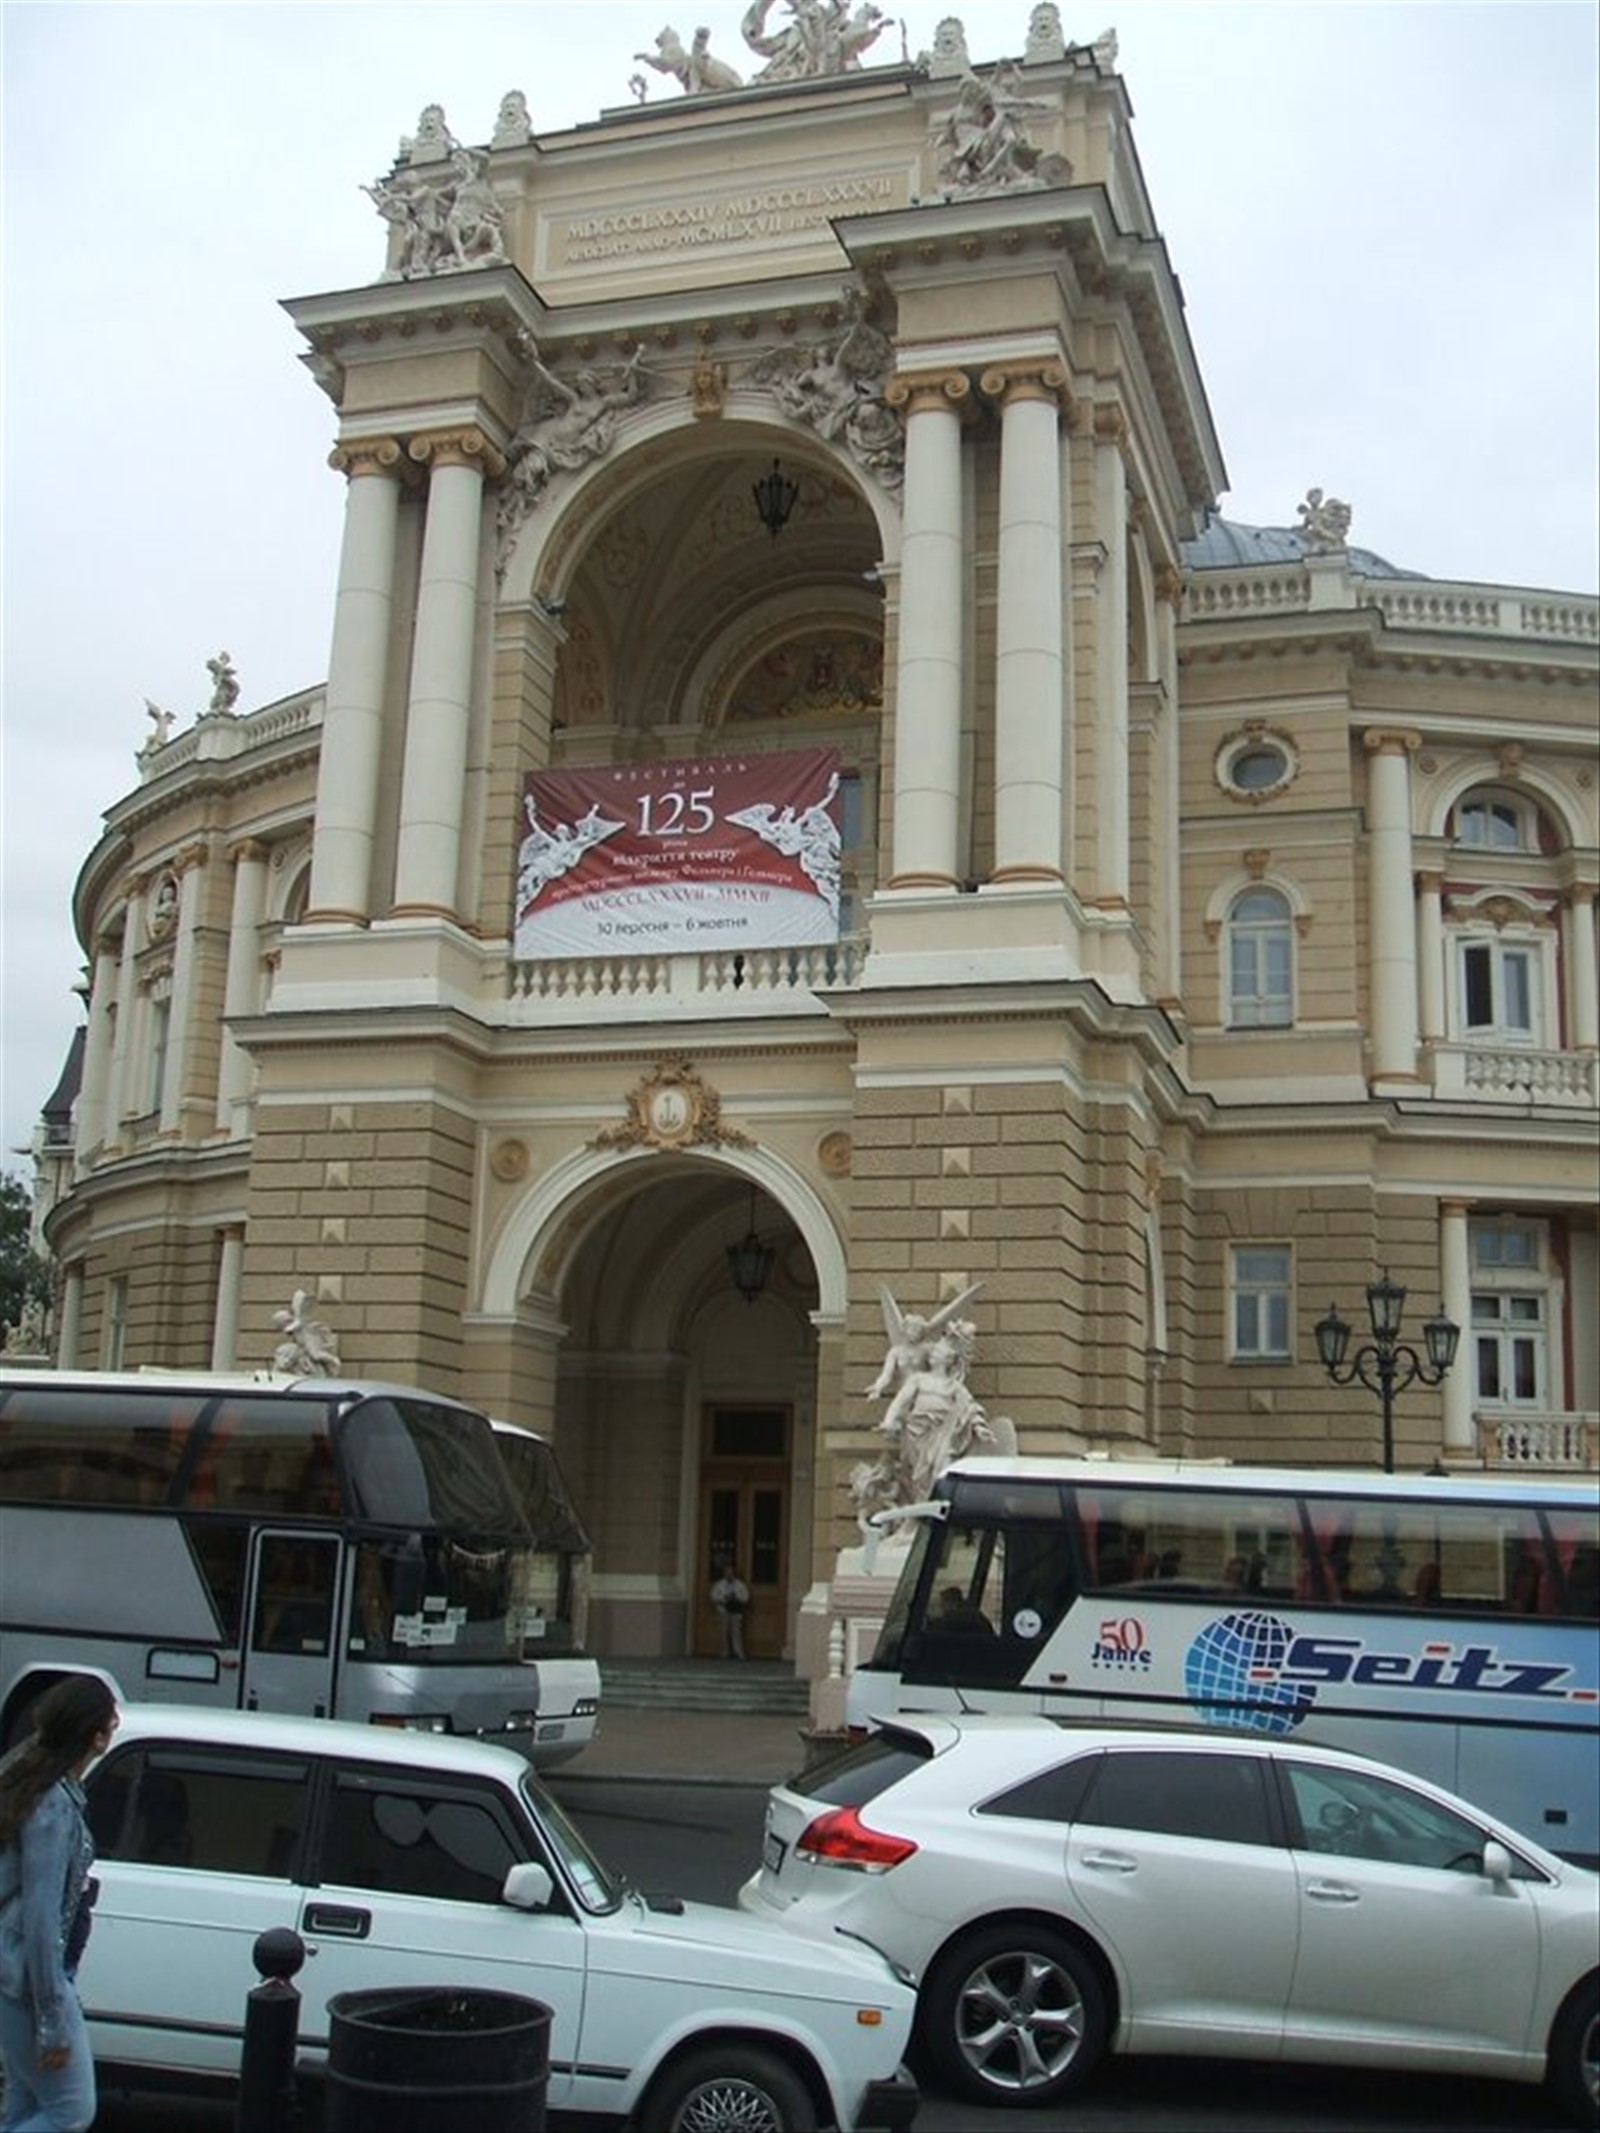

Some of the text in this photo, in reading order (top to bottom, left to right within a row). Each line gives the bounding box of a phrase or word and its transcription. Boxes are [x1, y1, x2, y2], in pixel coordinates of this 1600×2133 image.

[636, 786, 716, 837] 125
[688, 848, 740, 863] театру
[685, 917, 695, 932] 6
[696, 917, 748, 932] жовтня
[1099, 1617, 1145, 1651] 50
[1091, 1642, 1152, 1664] Jahre
[1281, 1636, 1568, 1697] Seitz
